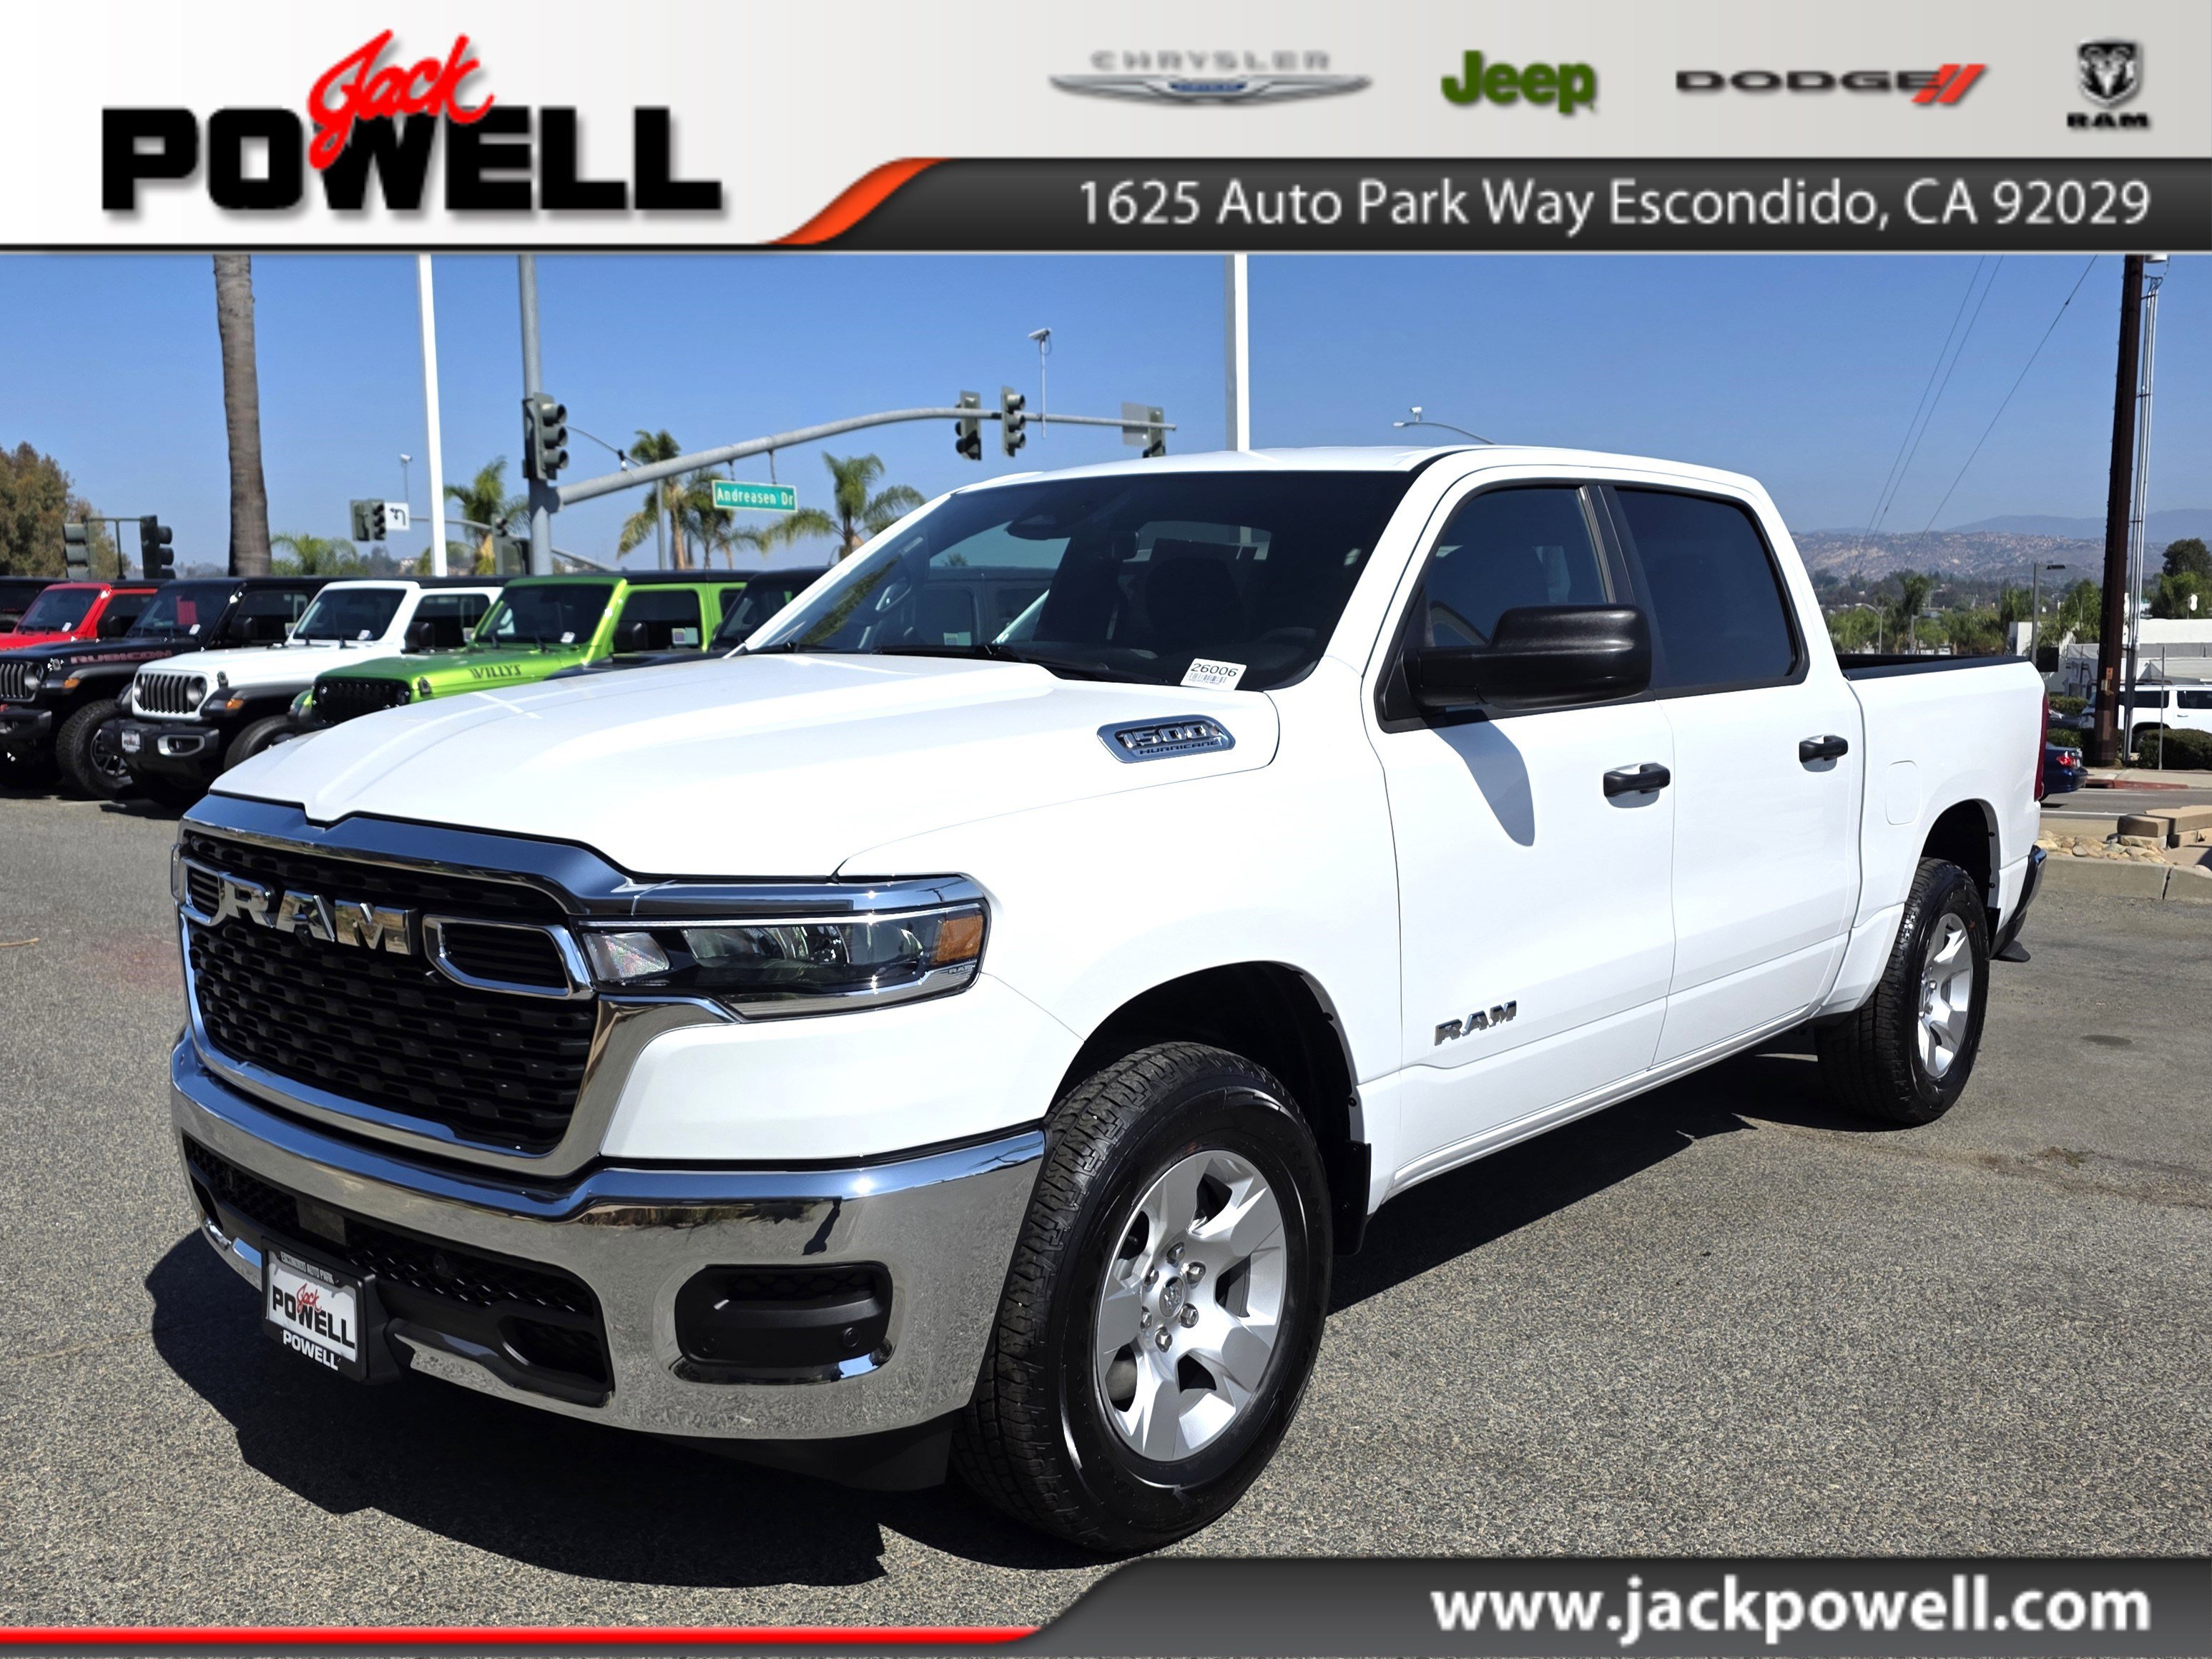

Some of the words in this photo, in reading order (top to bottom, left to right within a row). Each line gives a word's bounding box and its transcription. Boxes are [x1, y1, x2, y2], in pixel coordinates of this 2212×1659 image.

[717, 487, 777, 505] Andreasen
[780, 491, 794, 506] Dr
[70, 650, 173, 664] RUBICON
[1190, 663, 1239, 677] 26006
[1120, 724, 1211, 749] 1500
[1139, 738, 1224, 755] HURRICANE
[217, 872, 415, 955] RAM
[1434, 1000, 1517, 1046] RAM
[296, 1282, 323, 1314] Jack
[272, 1284, 355, 1349] POWELL
[282, 1329, 339, 1371] POWELL
